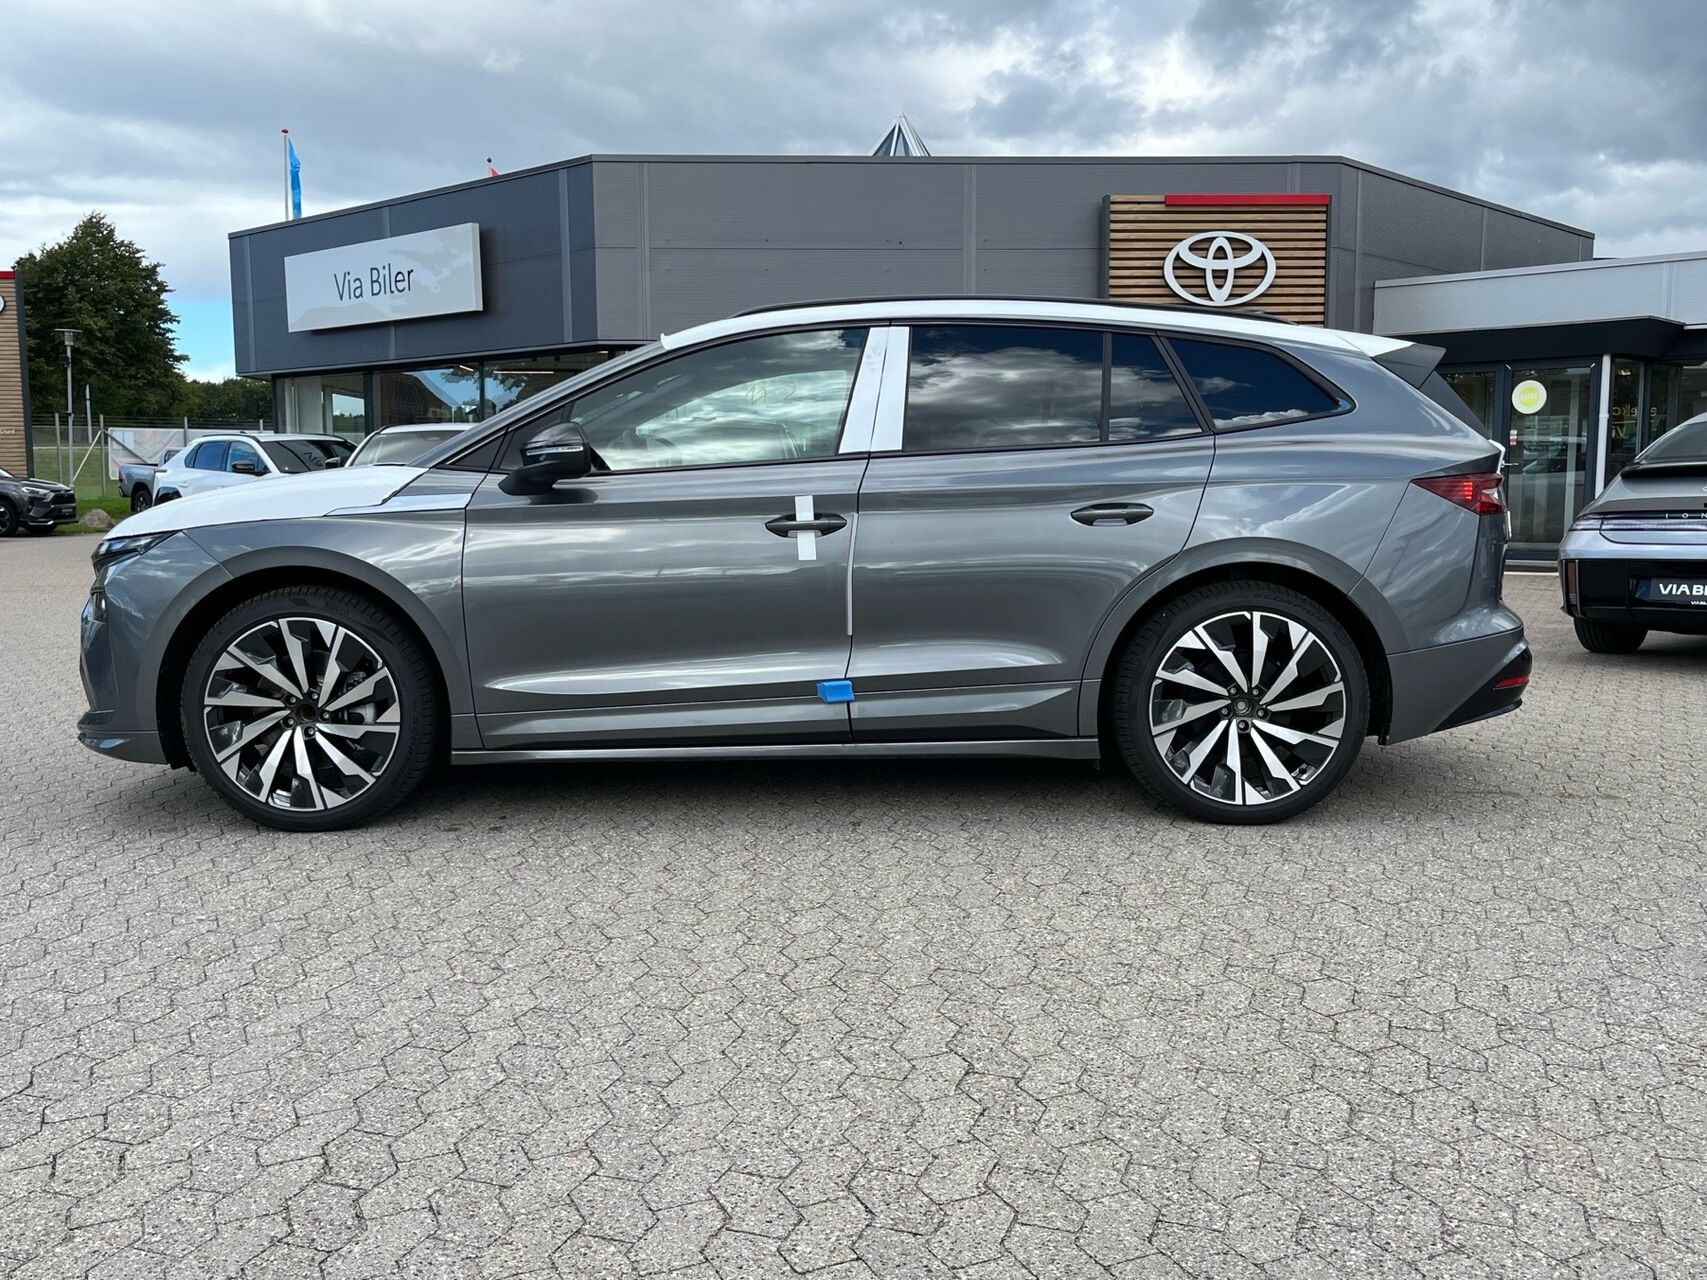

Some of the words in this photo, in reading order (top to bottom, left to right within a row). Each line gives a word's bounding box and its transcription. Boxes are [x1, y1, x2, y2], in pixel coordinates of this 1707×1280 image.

[333, 272, 363, 301] Via
[370, 263, 414, 297] Biler
[1659, 584, 1690, 596] VIA
